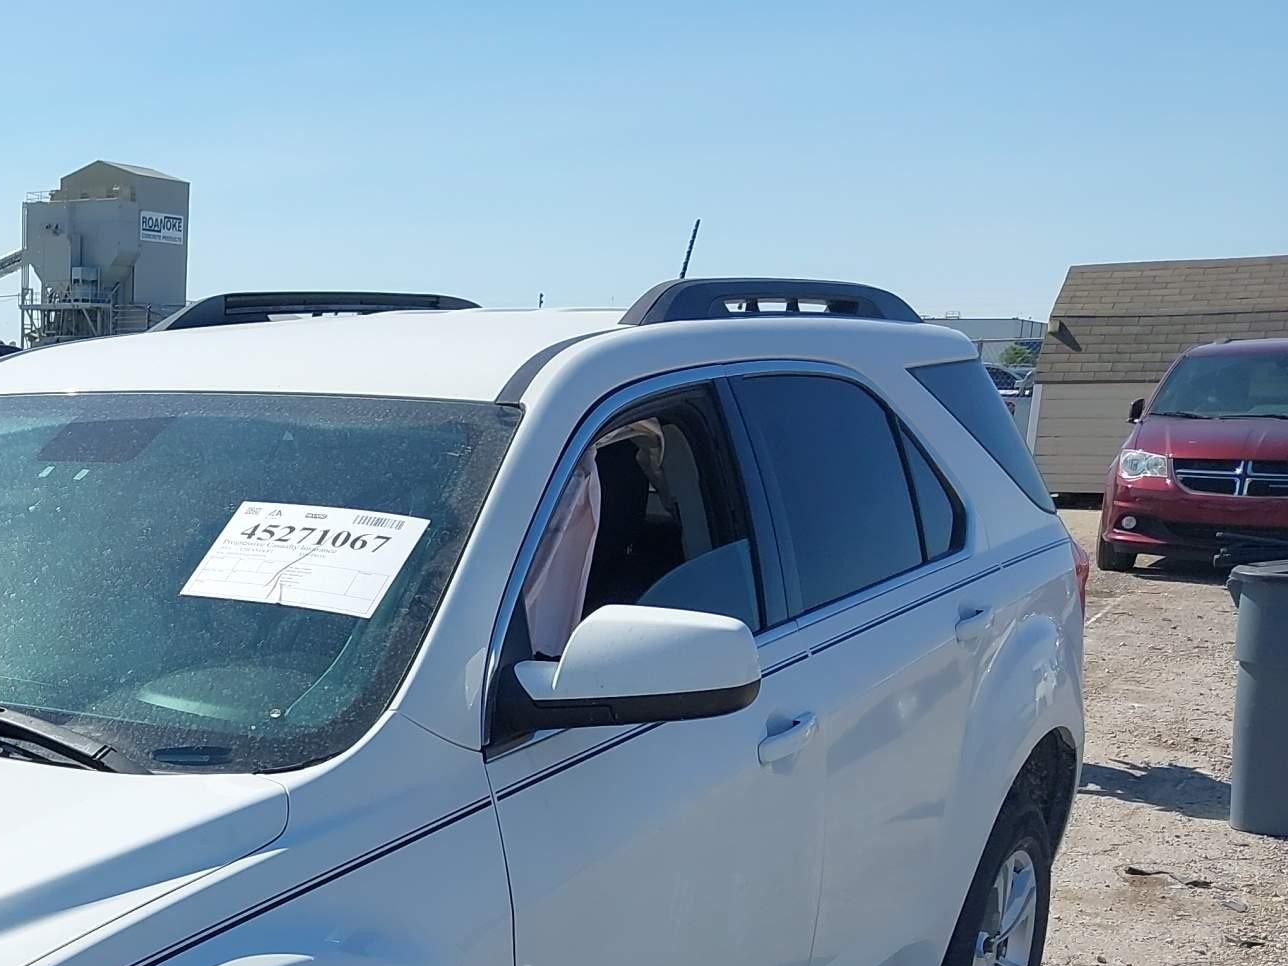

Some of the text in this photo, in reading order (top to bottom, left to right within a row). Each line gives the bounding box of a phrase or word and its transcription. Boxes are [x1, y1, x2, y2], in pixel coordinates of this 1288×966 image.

[142, 216, 182, 232] ROANOKE
[240, 523, 392, 552] 45271067
[266, 542, 297, 551] Casualty
